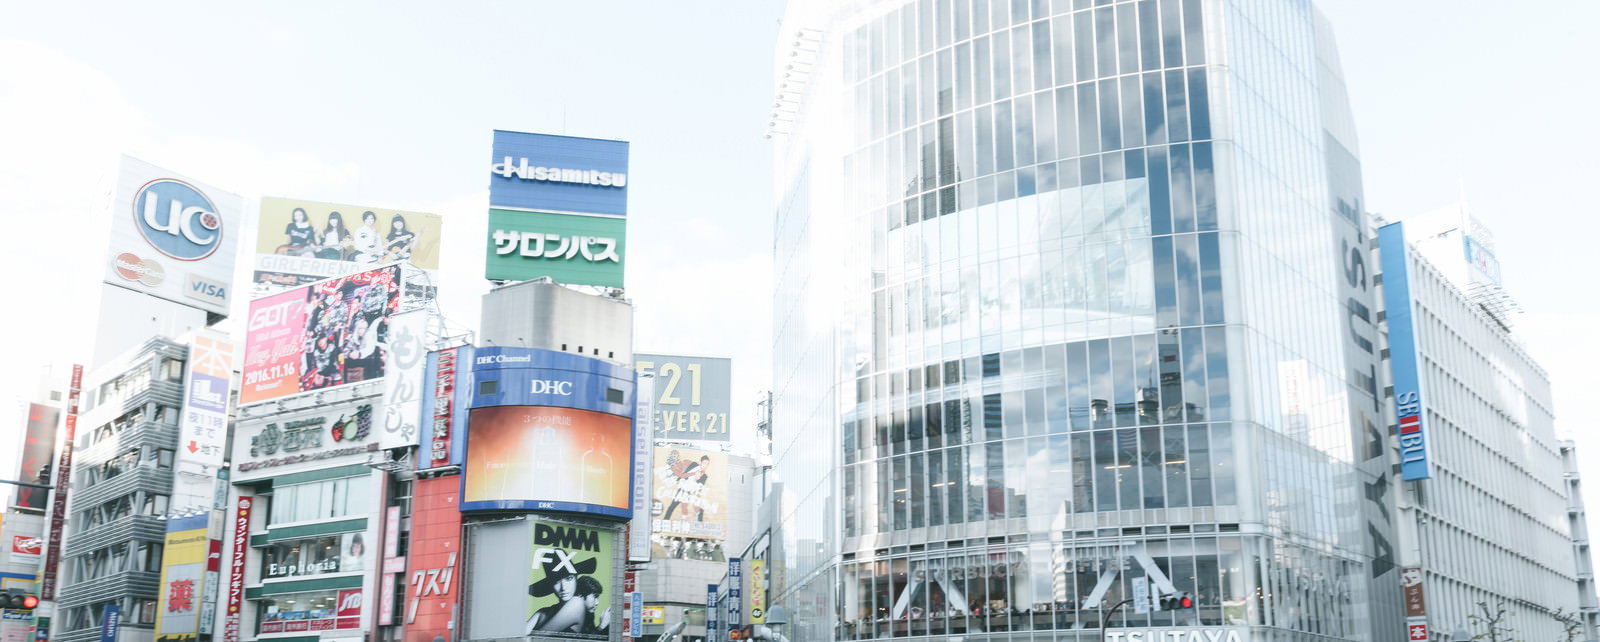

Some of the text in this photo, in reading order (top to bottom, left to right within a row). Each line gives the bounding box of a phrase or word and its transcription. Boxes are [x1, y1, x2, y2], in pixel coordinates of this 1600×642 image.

[492, 156, 626, 187] Hisamitsu
[492, 229, 619, 263] サロンパス
[191, 281, 226, 300] VISA
[190, 336, 233, 379] 本
[477, 354, 531, 365] DHC Channel
[384, 325, 422, 442] もんじゃ
[531, 379, 573, 396] DHC
[706, 412, 727, 433] 21
[534, 523, 600, 552] DMM
[270, 561, 336, 576] Euphoria
[532, 548, 577, 574] FX
[407, 552, 457, 624] クスリ
[730, 562, 740, 624] 洋服の青山
[338, 592, 363, 612] JTB
